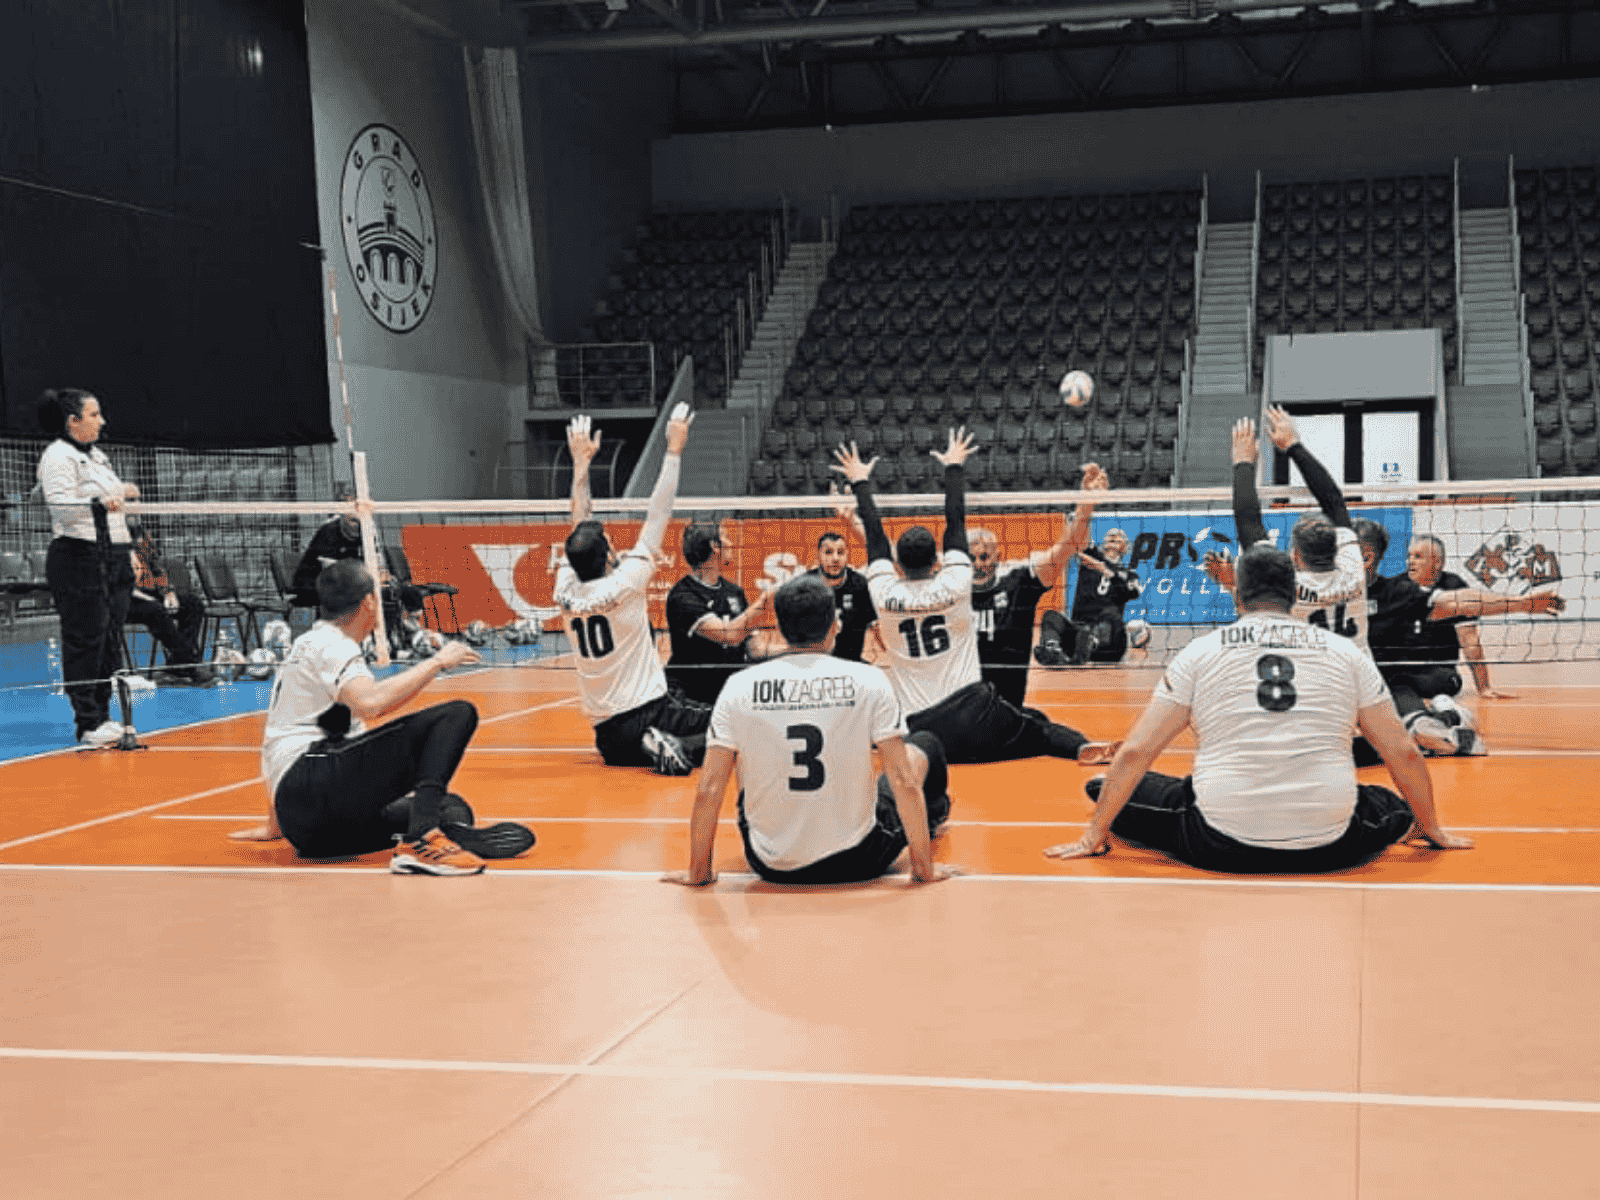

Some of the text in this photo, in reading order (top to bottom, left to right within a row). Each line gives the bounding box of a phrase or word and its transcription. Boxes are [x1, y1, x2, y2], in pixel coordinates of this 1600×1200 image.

[356, 263, 431, 327] OSIJEK
[571, 614, 614, 658] 10
[899, 615, 950, 657] 16
[1256, 653, 1297, 713] 8
[786, 723, 825, 792] 3
